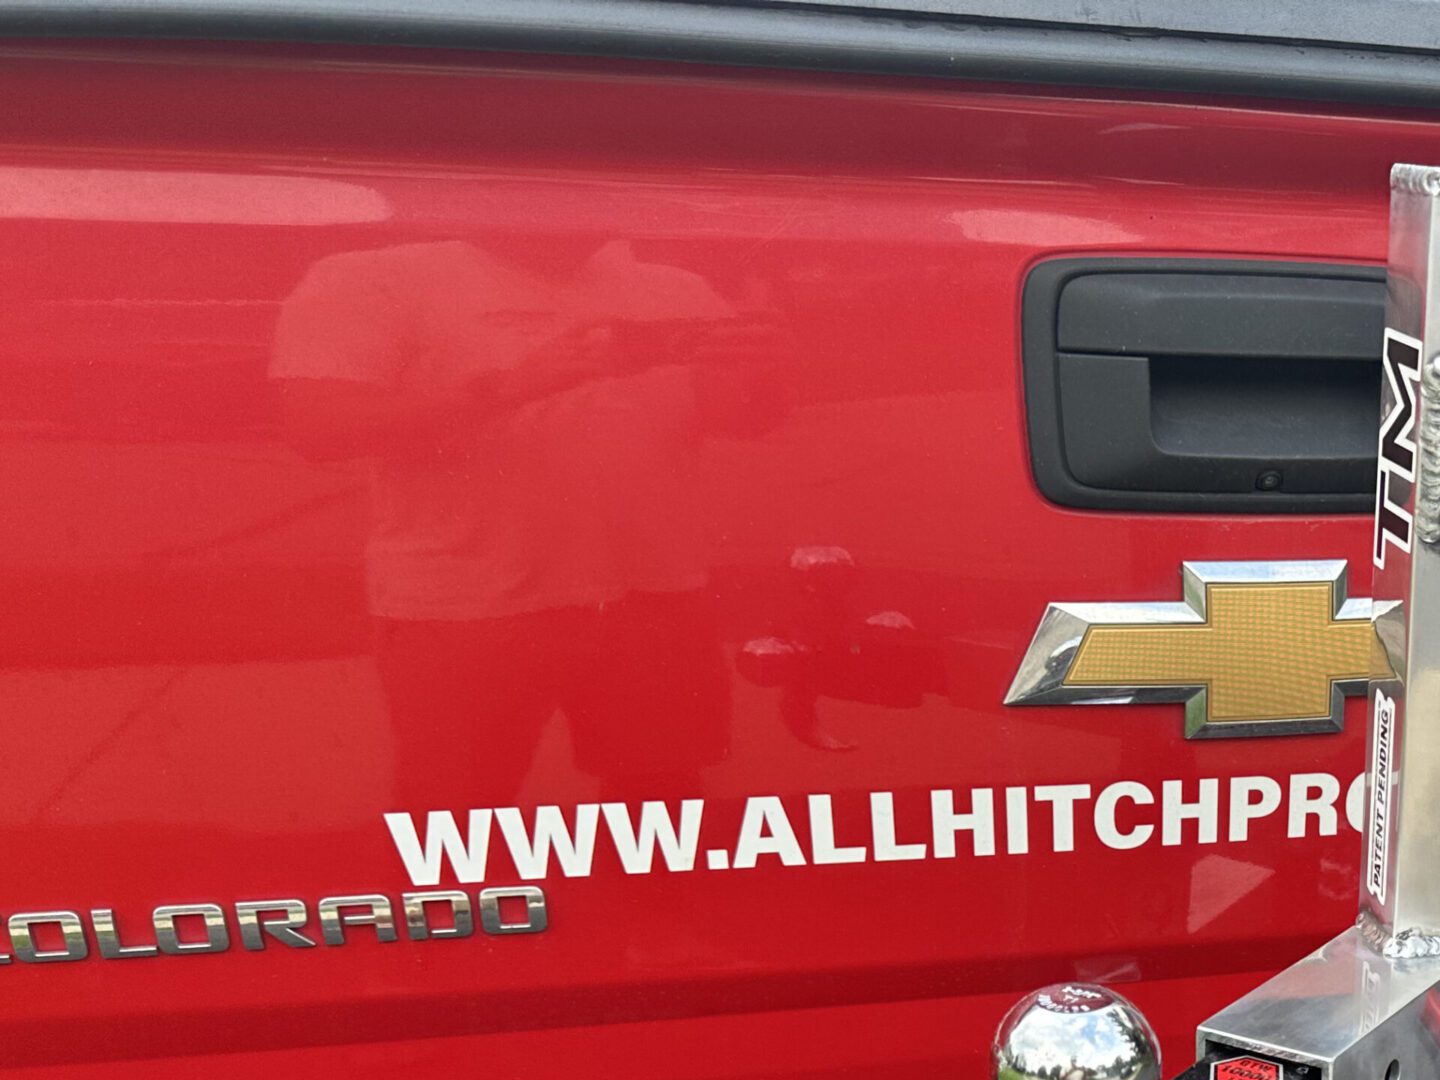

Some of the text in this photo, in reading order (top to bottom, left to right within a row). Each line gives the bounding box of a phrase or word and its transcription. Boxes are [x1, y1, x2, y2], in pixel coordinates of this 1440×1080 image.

[1373, 327, 1422, 570] TM
[1374, 710, 1390, 887] PATENT PENDING
